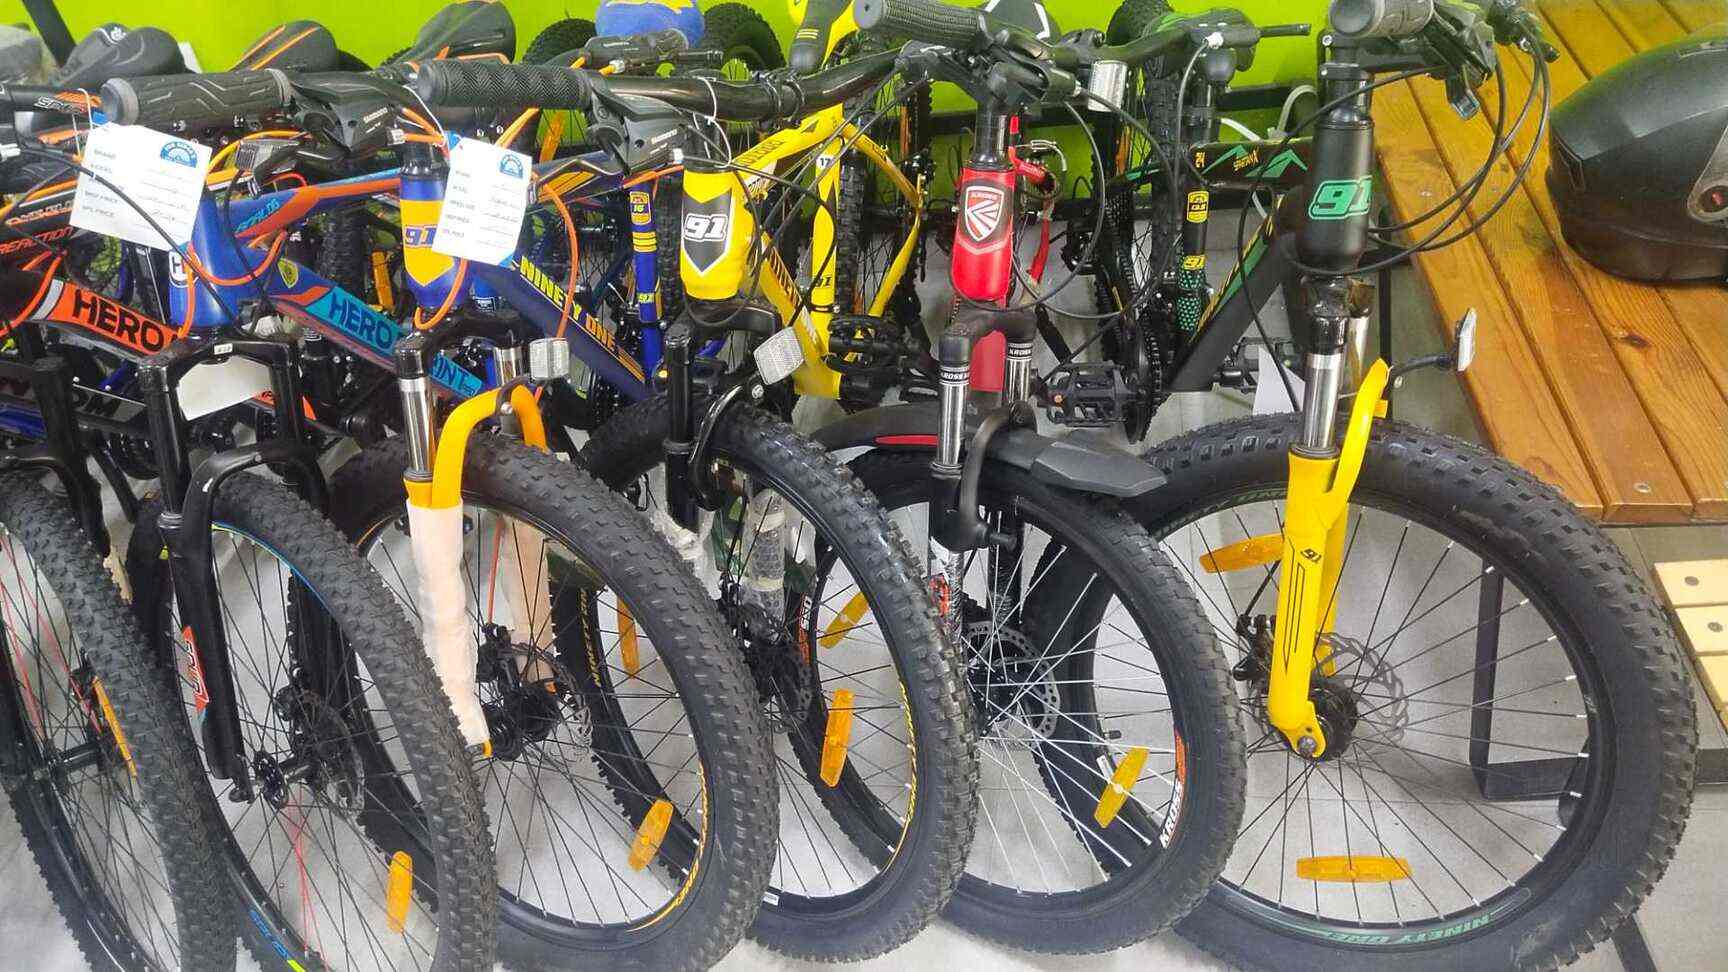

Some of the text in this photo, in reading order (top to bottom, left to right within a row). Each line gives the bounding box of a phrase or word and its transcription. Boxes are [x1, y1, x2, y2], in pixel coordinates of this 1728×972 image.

[1309, 175, 1373, 219] 91
[403, 225, 438, 248] 91
[683, 213, 728, 242] 91
[72, 289, 164, 352] HERO
[327, 292, 393, 350] HERO
[519, 255, 617, 351] NINEY ONE
[1160, 780, 1183, 849] KROSS
